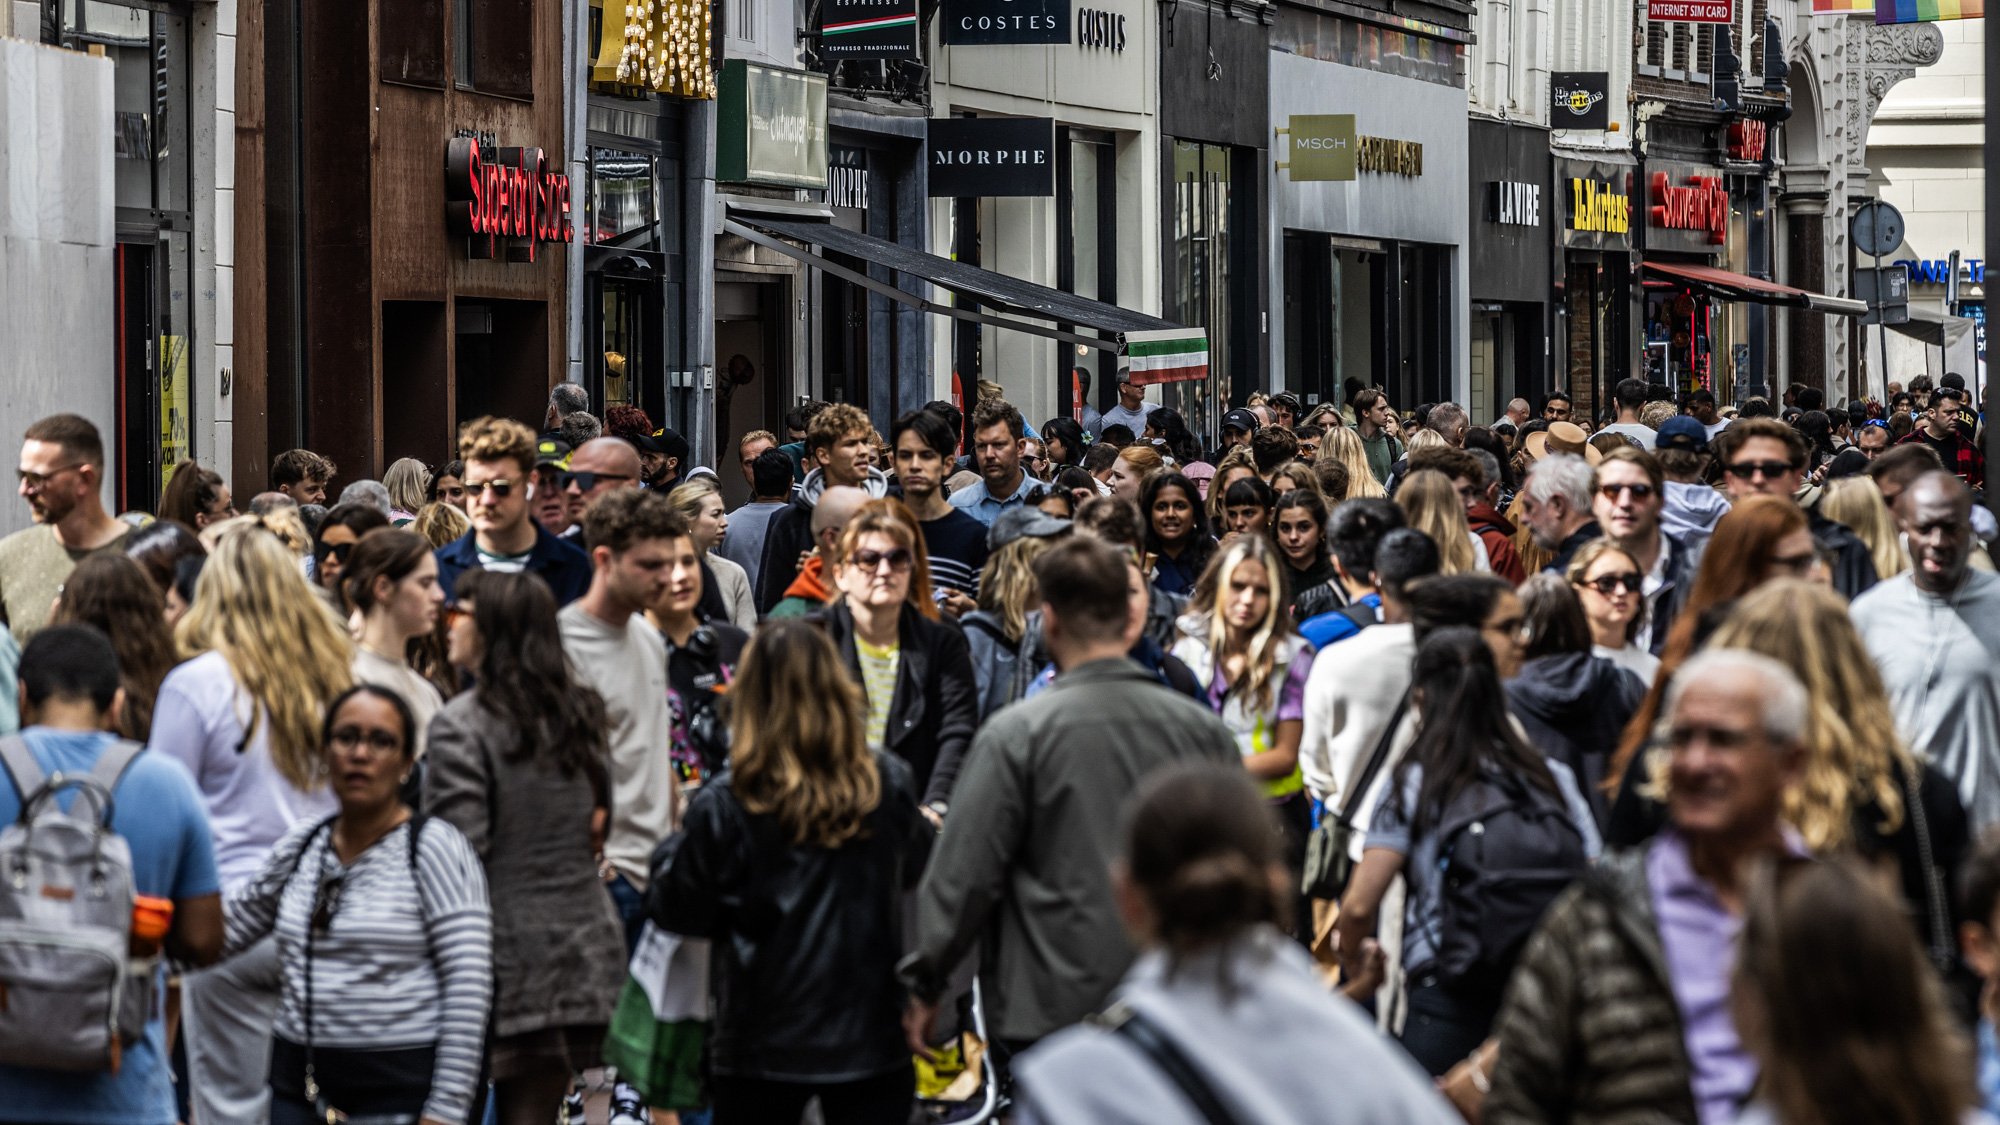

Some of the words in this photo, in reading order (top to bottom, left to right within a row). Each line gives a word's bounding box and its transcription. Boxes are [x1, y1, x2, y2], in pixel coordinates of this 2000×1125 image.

[1651, 3, 1688, 17] INTERNET
[1690, 4, 1705, 17] SIM
[1706, 6, 1728, 18] CARD
[961, 16, 1056, 30] COSTES
[1297, 138, 1346, 149] MSCH
[936, 150, 1045, 165] MORPHE
[1358, 135, 1422, 176] COPENHAGEN
[469, 138, 537, 262] Superdry
[1663, 171, 1707, 231] Souvenir
[1709, 176, 1728, 245] City
